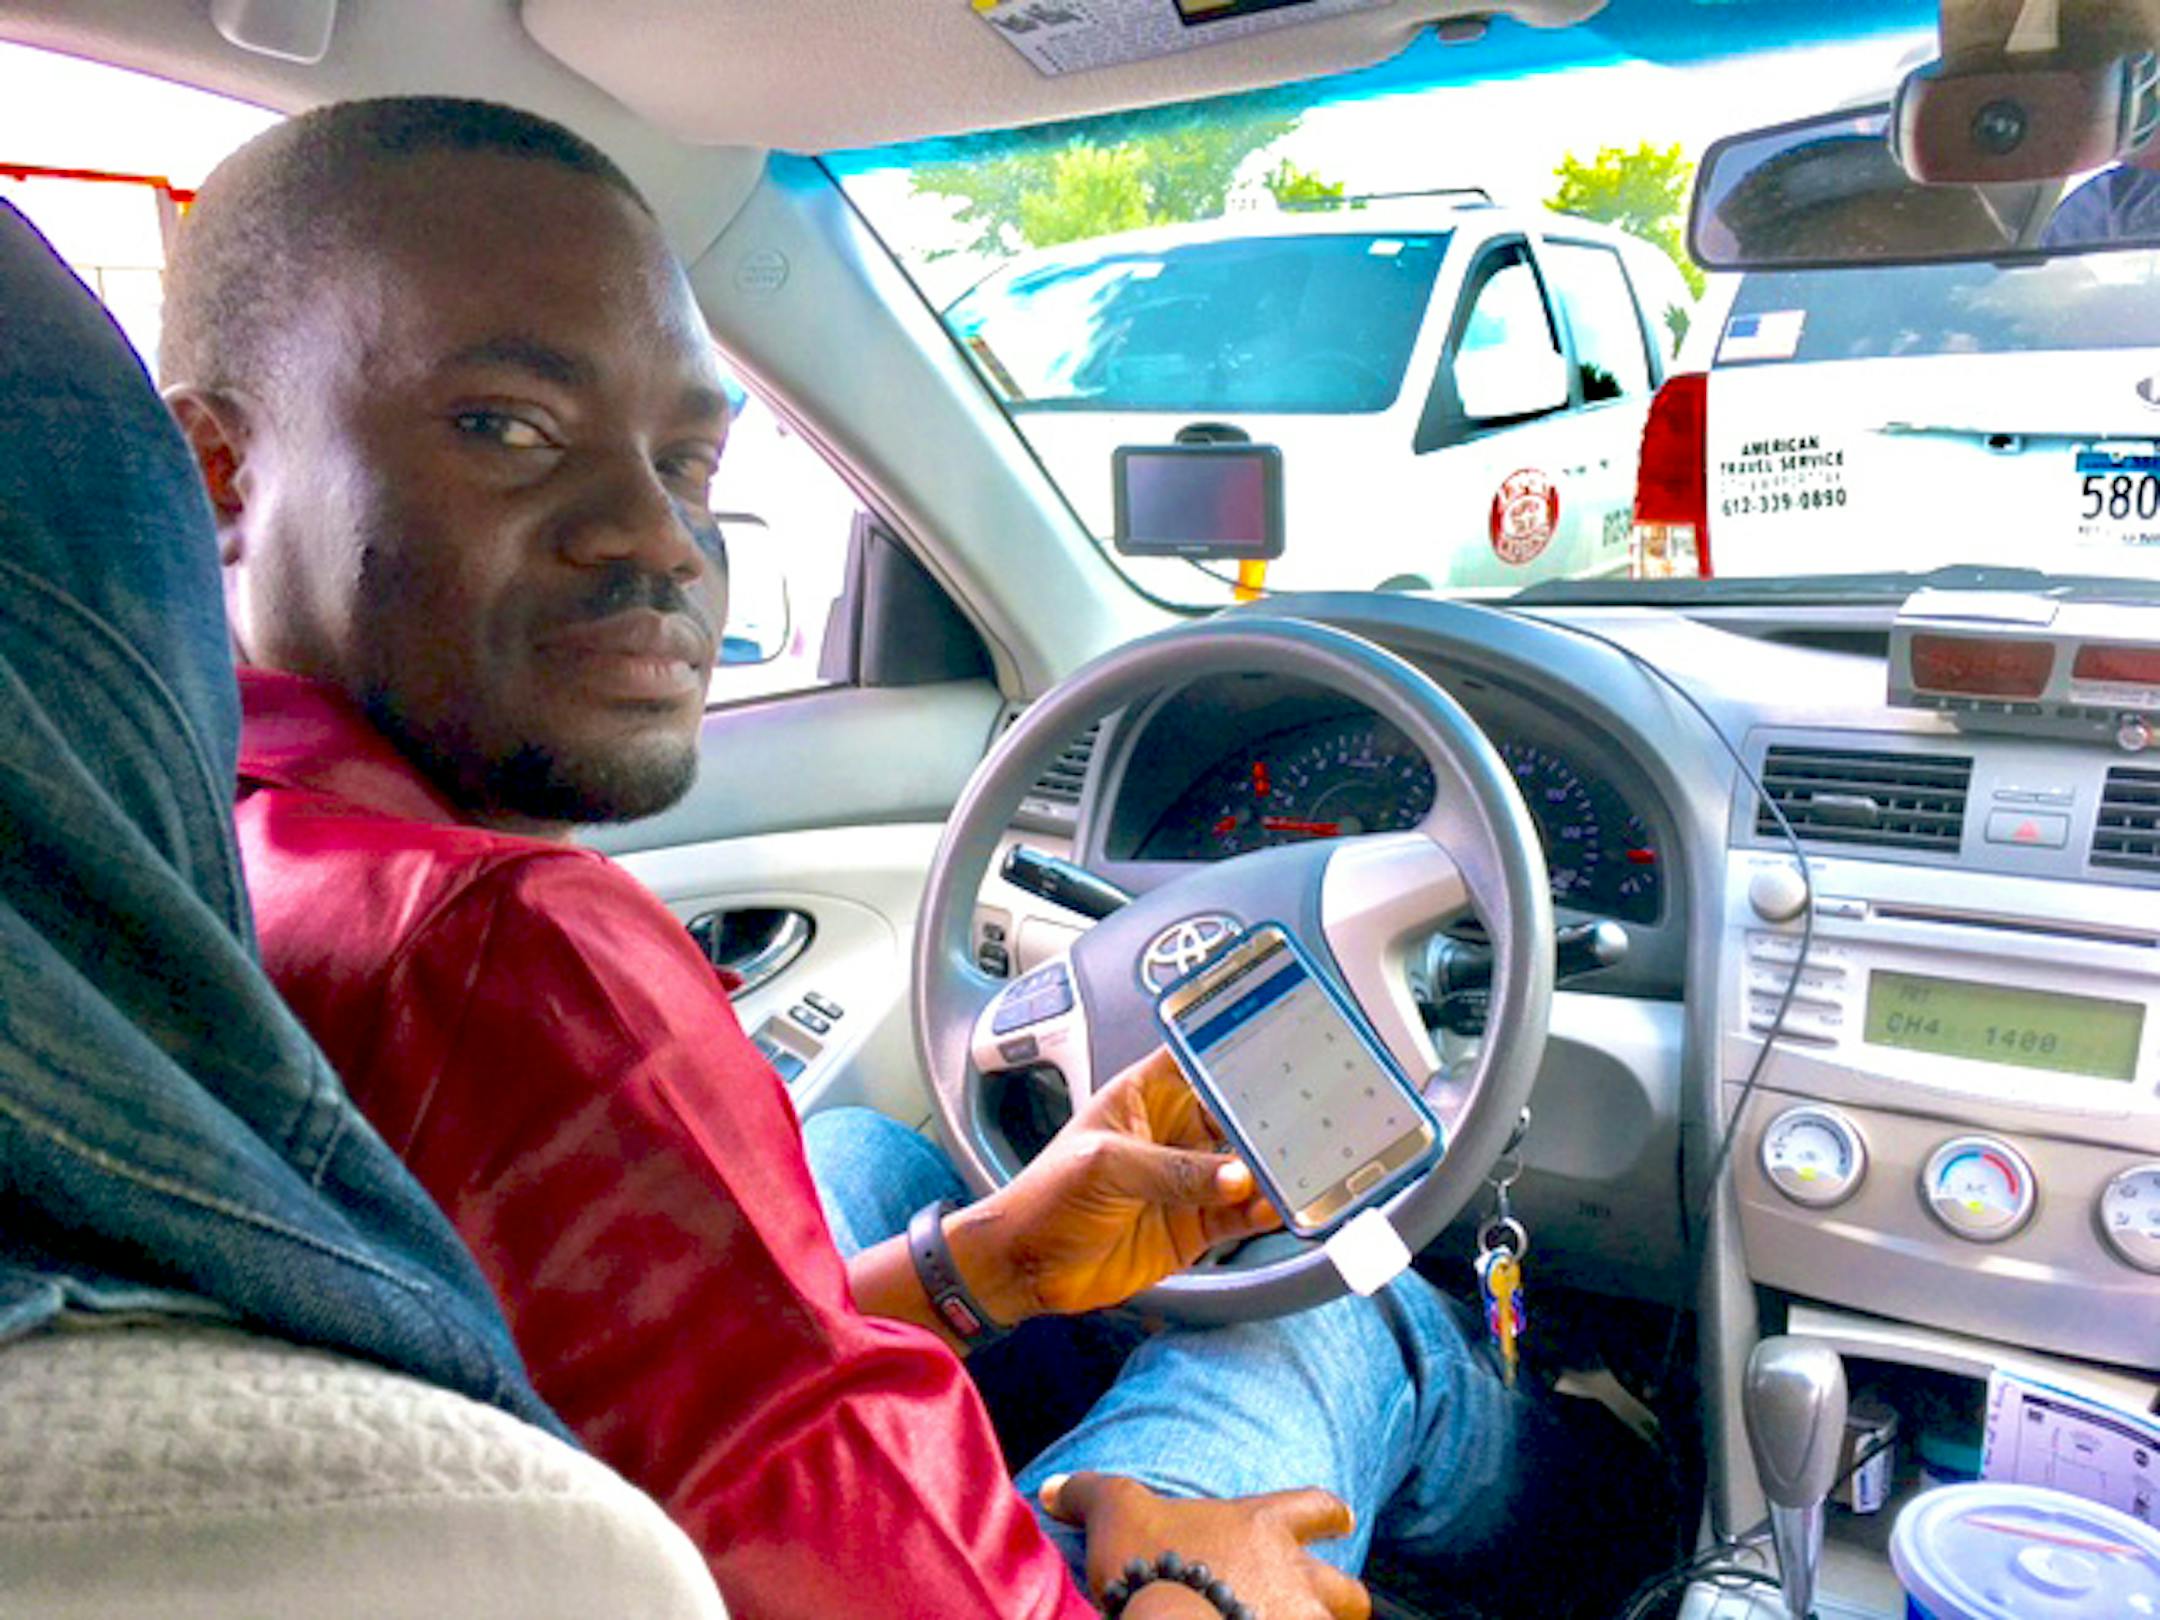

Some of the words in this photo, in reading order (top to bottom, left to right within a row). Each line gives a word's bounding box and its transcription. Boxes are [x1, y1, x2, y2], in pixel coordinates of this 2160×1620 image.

[1741, 435, 1820, 456] AMERICAN
[1720, 458, 1773, 476] TRAVEL
[1780, 449, 1844, 472] SERVICE
[1720, 486, 1848, 517] 612-339-0890
[2081, 474, 2158, 520] 580
[1885, 1010, 1942, 1036] CH4
